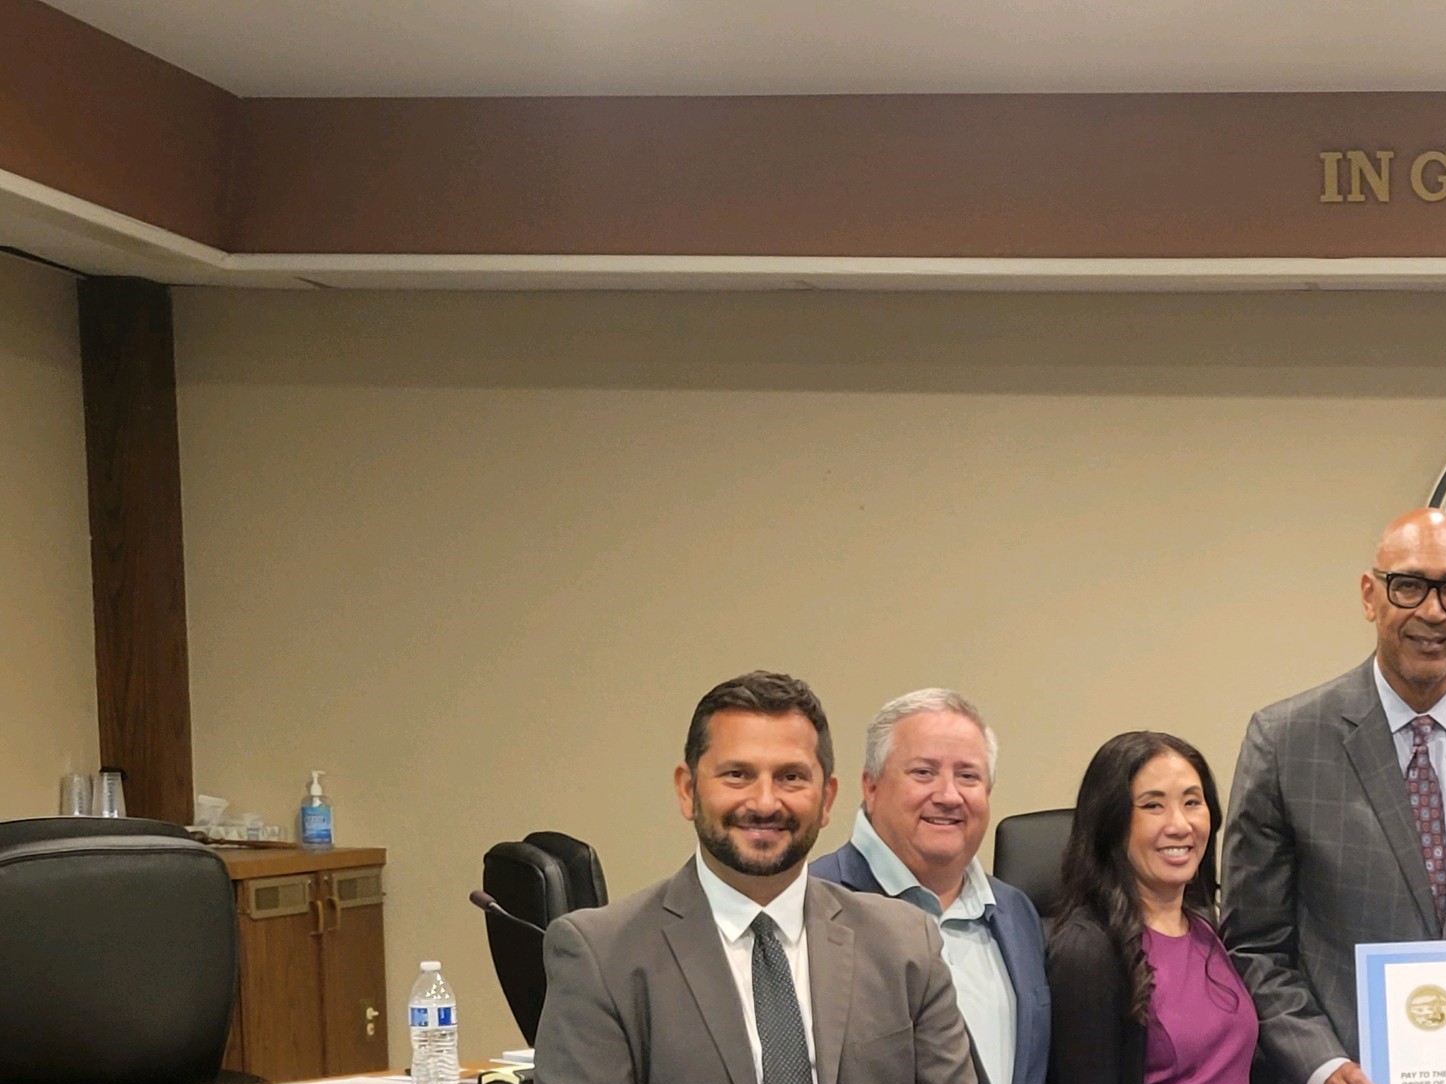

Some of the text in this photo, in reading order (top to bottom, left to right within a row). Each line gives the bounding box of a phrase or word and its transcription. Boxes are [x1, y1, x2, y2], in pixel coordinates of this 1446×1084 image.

[1320, 151, 1394, 202] IN
[1401, 1071, 1416, 1079] PAY
[1418, 1071, 1430, 1079] TO
